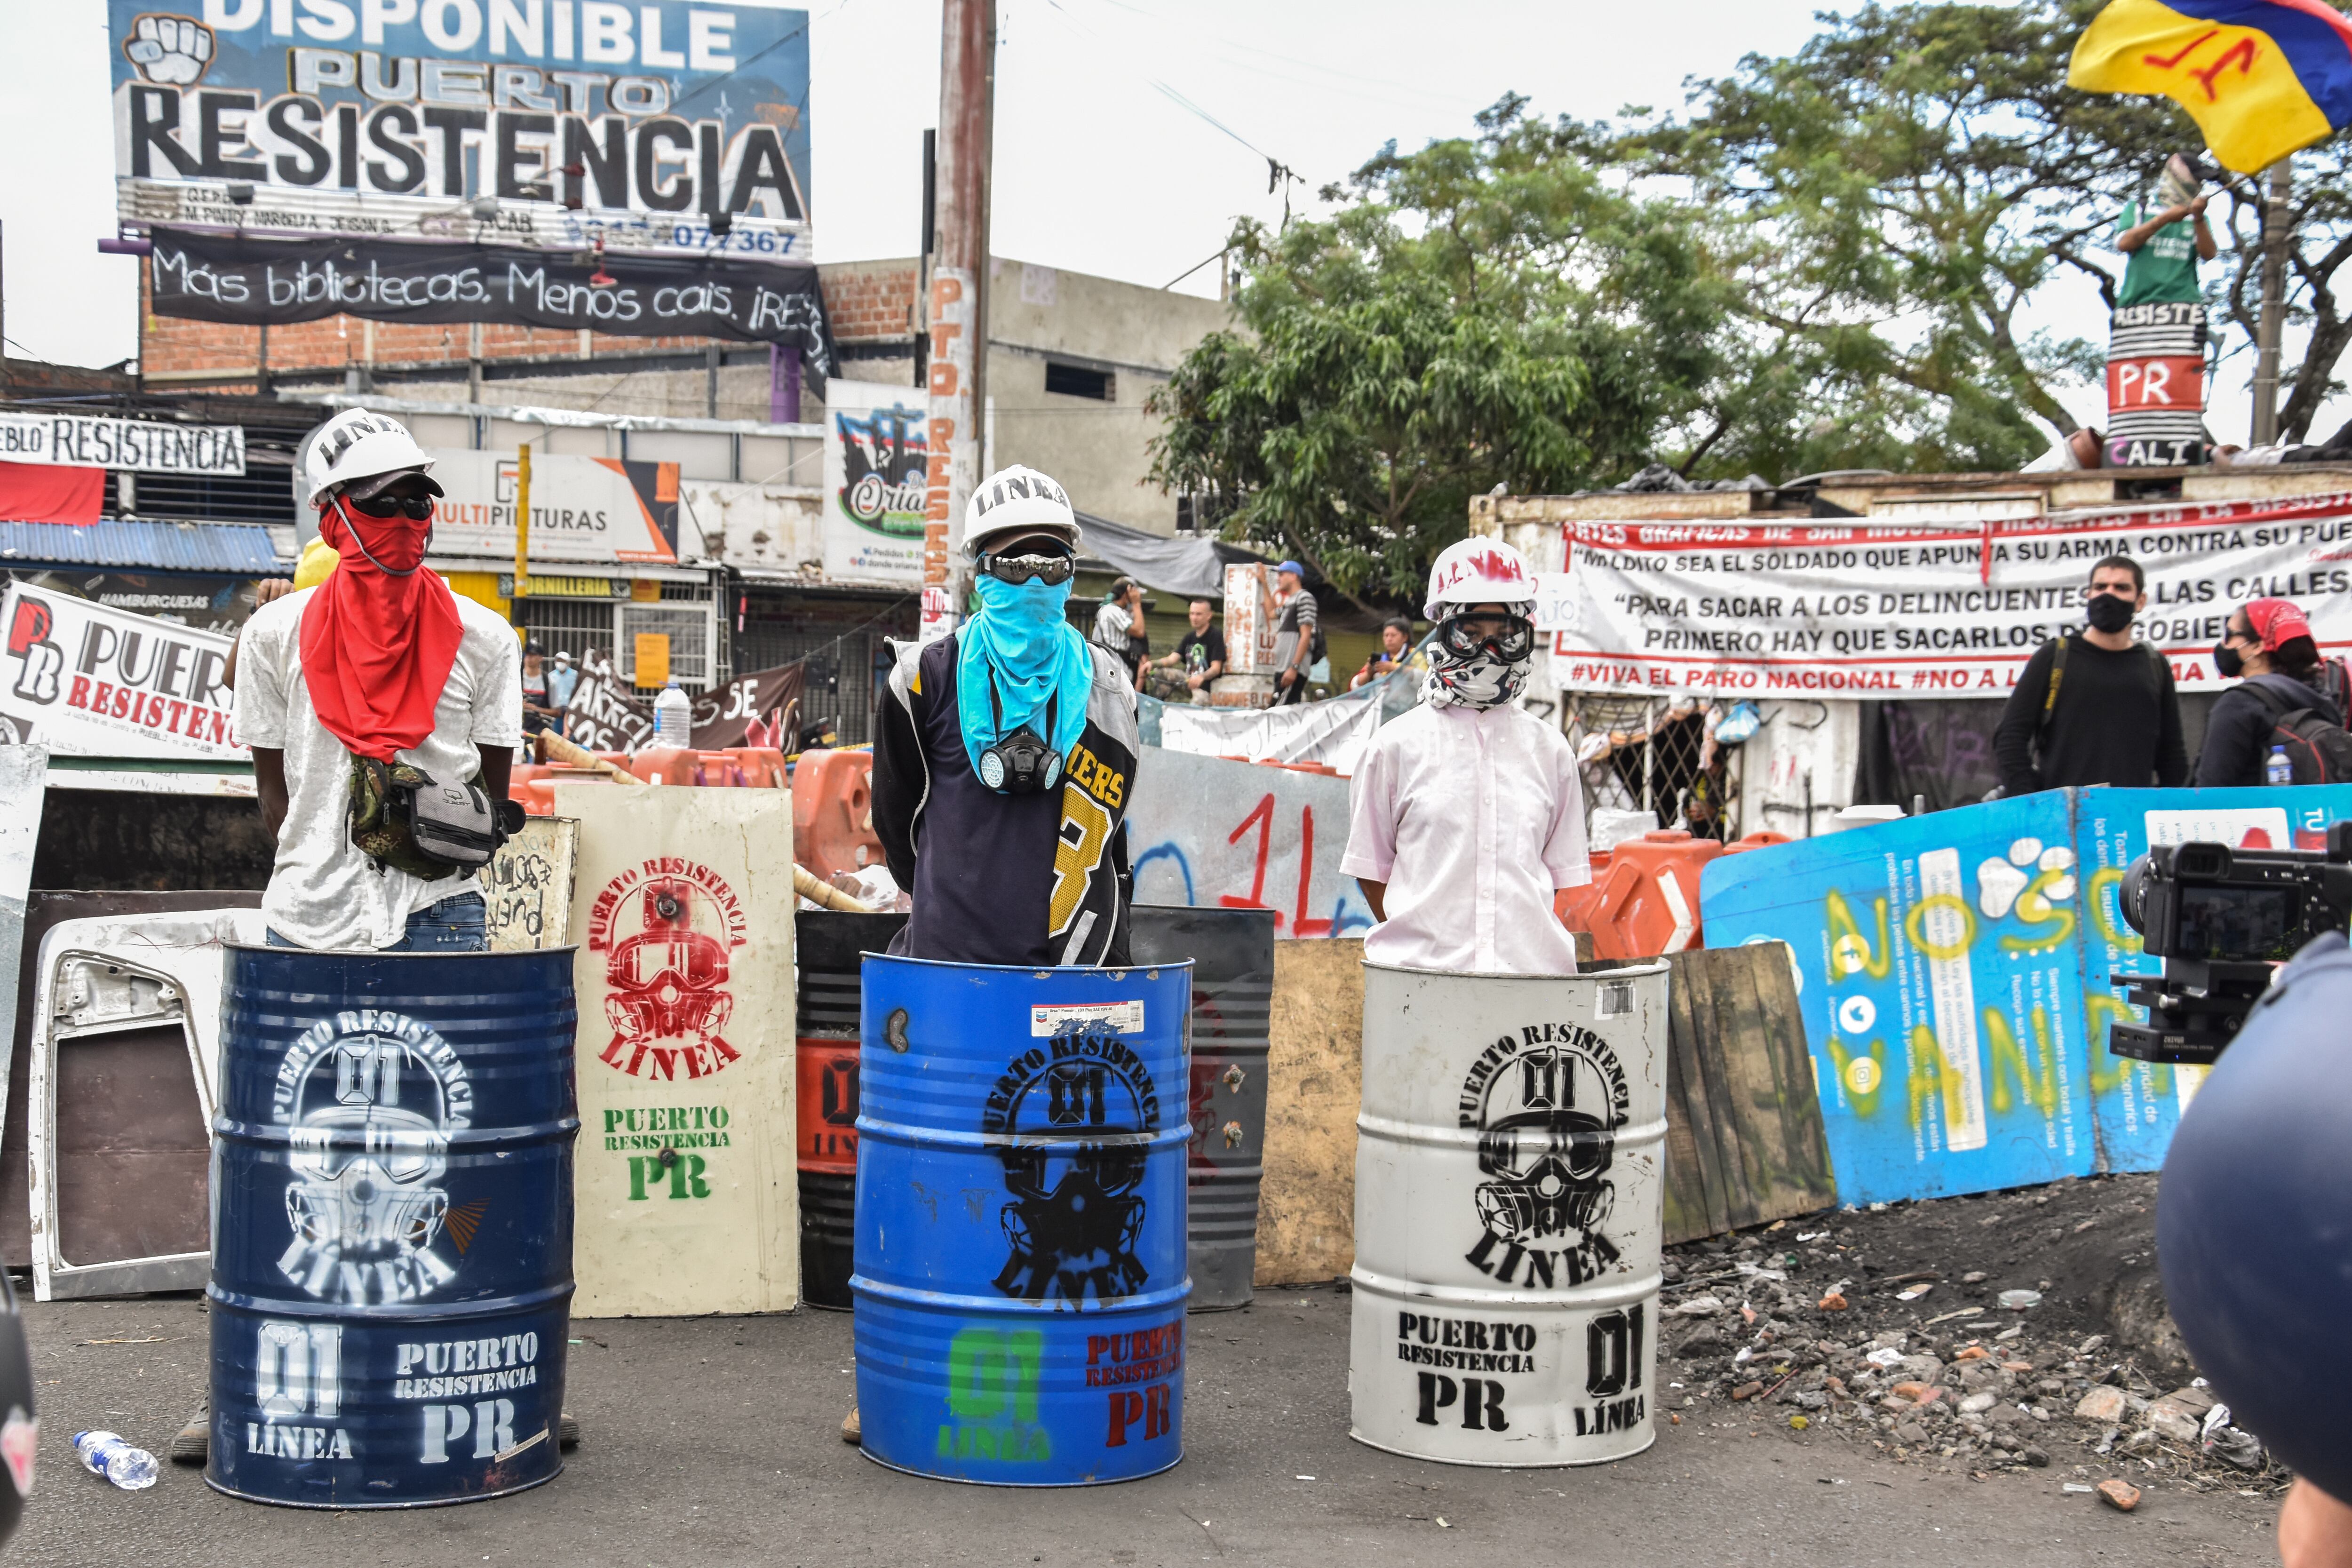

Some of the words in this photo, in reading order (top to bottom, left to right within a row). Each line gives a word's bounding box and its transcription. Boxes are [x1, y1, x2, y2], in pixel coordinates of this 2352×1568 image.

[288, 48, 670, 116] PUERTO
[129, 84, 804, 220] RESISTENCIA
[153, 248, 250, 302] Más
[509, 263, 641, 321] Menos
[2114, 303, 2203, 326] RESISTE
[2118, 362, 2172, 406] PR
[51, 419, 241, 470] RESISTENCIA
[2111, 436, 2193, 467] CALI
[432, 503, 607, 532] ULTIPITURAS
[1675, 555, 1715, 572] SEA
[1724, 556, 1745, 571] EL
[1752, 551, 1857, 571] SOLDADO
[1866, 549, 1910, 569] QUE
[1918, 541, 2010, 565] APUNA
[2018, 541, 2048, 560] SU
[2057, 538, 2131, 558] ARMA
[2140, 531, 2245, 554] CONTRA
[2254, 528, 2289, 547] SU
[98, 593, 210, 610] HAMBURGUESAS
[1698, 597, 1782, 617] SACAR
[1791, 596, 1807, 616] A
[1817, 595, 1870, 616] LOS
[2156, 581, 2215, 604] LAS
[1644, 629, 1762, 652] PRIMERO
[1771, 629, 1823, 652] HAY
[1832, 629, 1886, 653] QUE
[1894, 625, 2048, 650] SACARLOS
[723, 678, 759, 720] SE
[1571, 664, 1642, 685] #VIVA
[1649, 668, 1676, 686] EL
[1685, 670, 1757, 688] PARO
[1766, 670, 1901, 690] NACIONAL
[1912, 669, 1970, 688] #NO
[1978, 669, 1996, 687] A
[1884, 852, 1900, 905] prohibidas
[588, 868, 638, 952] PUERTO
[642, 857, 747, 947] RESISTENCIA
[1891, 923, 1906, 958] peleas
[1895, 959, 1909, 987] entre
[1911, 955, 1926, 999] nacional
[2010, 974, 2025, 1015] Recoge
[2030, 971, 2042, 987] No
[2031, 988, 2043, 998] lo
[2047, 967, 2062, 1011] Siempre
[1897, 987, 1913, 1027] caninos
[2014, 1017, 2026, 1035] sus
[273, 1020, 334, 1122] PUERTO
[337, 1009, 472, 1128] RESISTENCIA
[335, 1043, 400, 1106] 01
[1459, 1035, 1517, 1129] PUERTO
[1521, 1023, 1630, 1128] RESISTENCIA
[1521, 1054, 1577, 1109] 01
[2016, 1037, 2033, 1105] excrementos
[2056, 1064, 2068, 1084] con
[604, 1106, 729, 1133] PUERTO
[2058, 1085, 2071, 1114] bozal
[604, 1131, 731, 1151] RESISTENCIA
[2043, 1121, 2057, 1148] edad
[627, 1154, 712, 1201] PR
[396, 1331, 539, 1375] PUERTO
[1086, 1319, 1182, 1365] PUERTO
[1398, 1311, 1537, 1352] PUERTO
[1586, 1303, 1644, 1398] 01
[257, 1322, 342, 1417] 01
[949, 1328, 1041, 1423] 01
[1398, 1343, 1535, 1373] RESISTENCIA
[394, 1364, 537, 1399] RESISTENCIA
[1416, 1371, 1510, 1432] PR
[420, 1398, 518, 1464] PR
[1106, 1382, 1171, 1448] PR
[1573, 1393, 1645, 1437] LÍNEA
